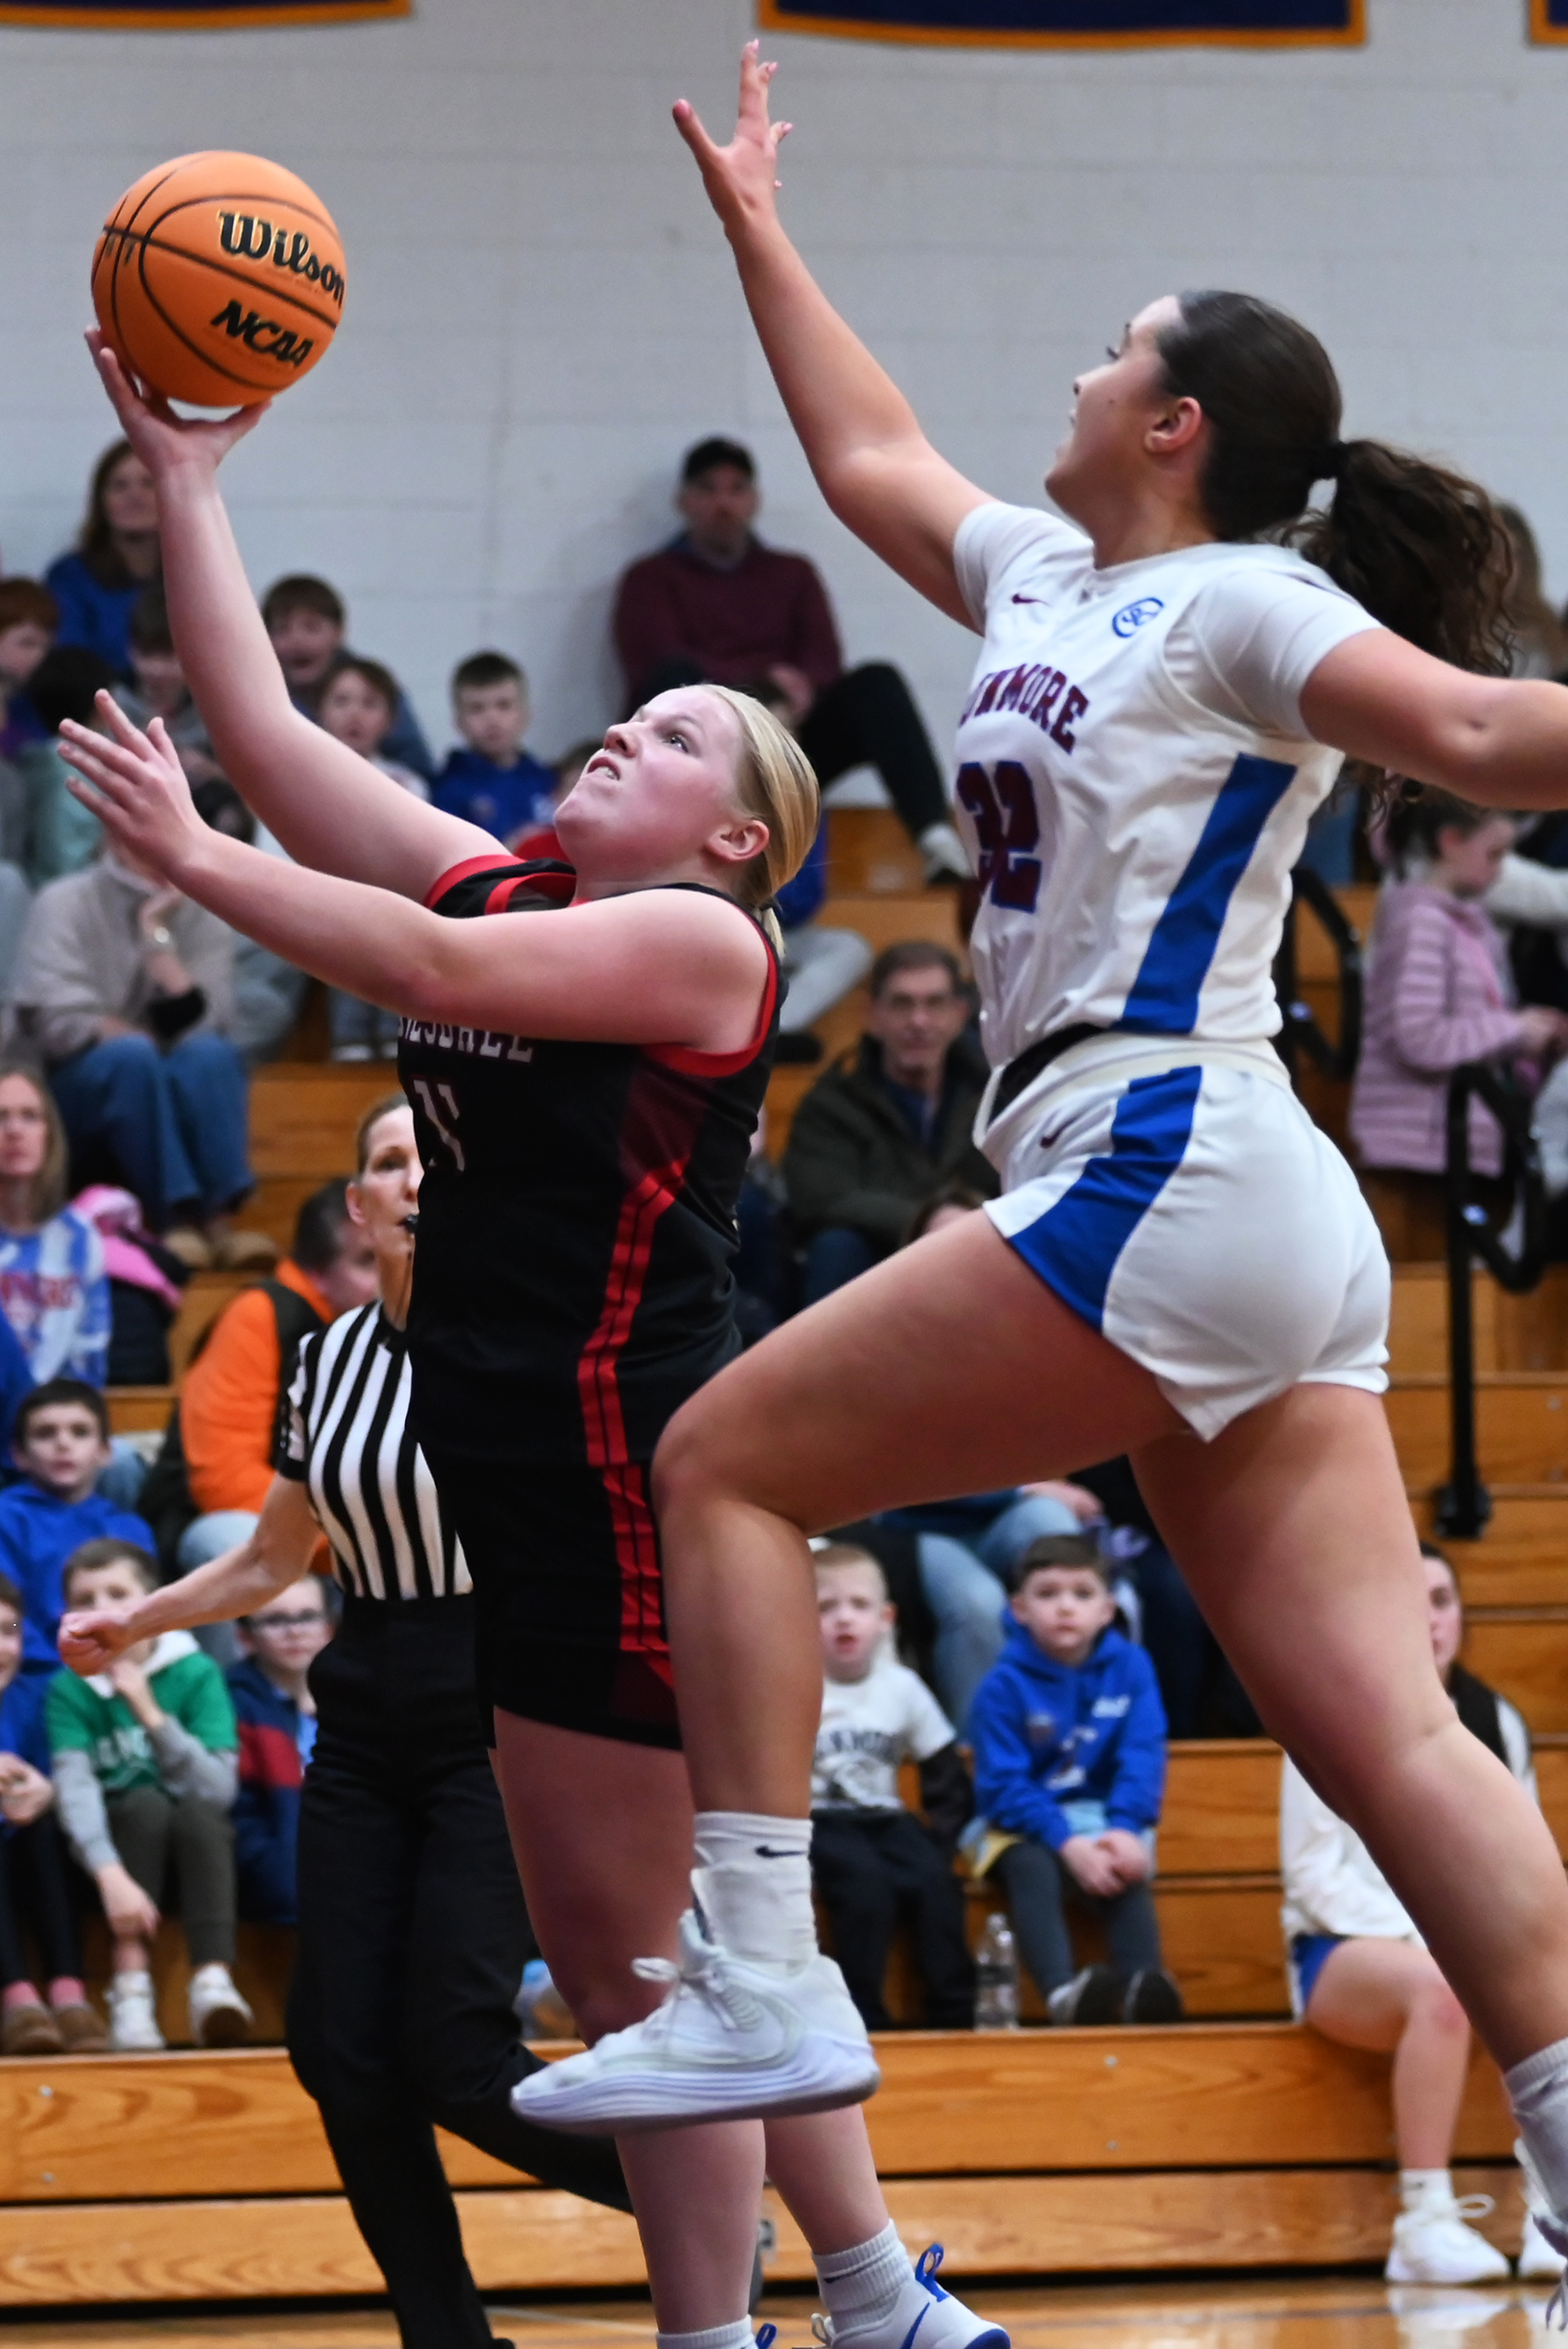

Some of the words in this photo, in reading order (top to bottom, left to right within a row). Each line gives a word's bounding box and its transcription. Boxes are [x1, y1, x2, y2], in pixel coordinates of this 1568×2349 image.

[216, 209, 344, 309] Wilson
[210, 299, 313, 367] NCAA
[959, 663, 1090, 756] NMORE
